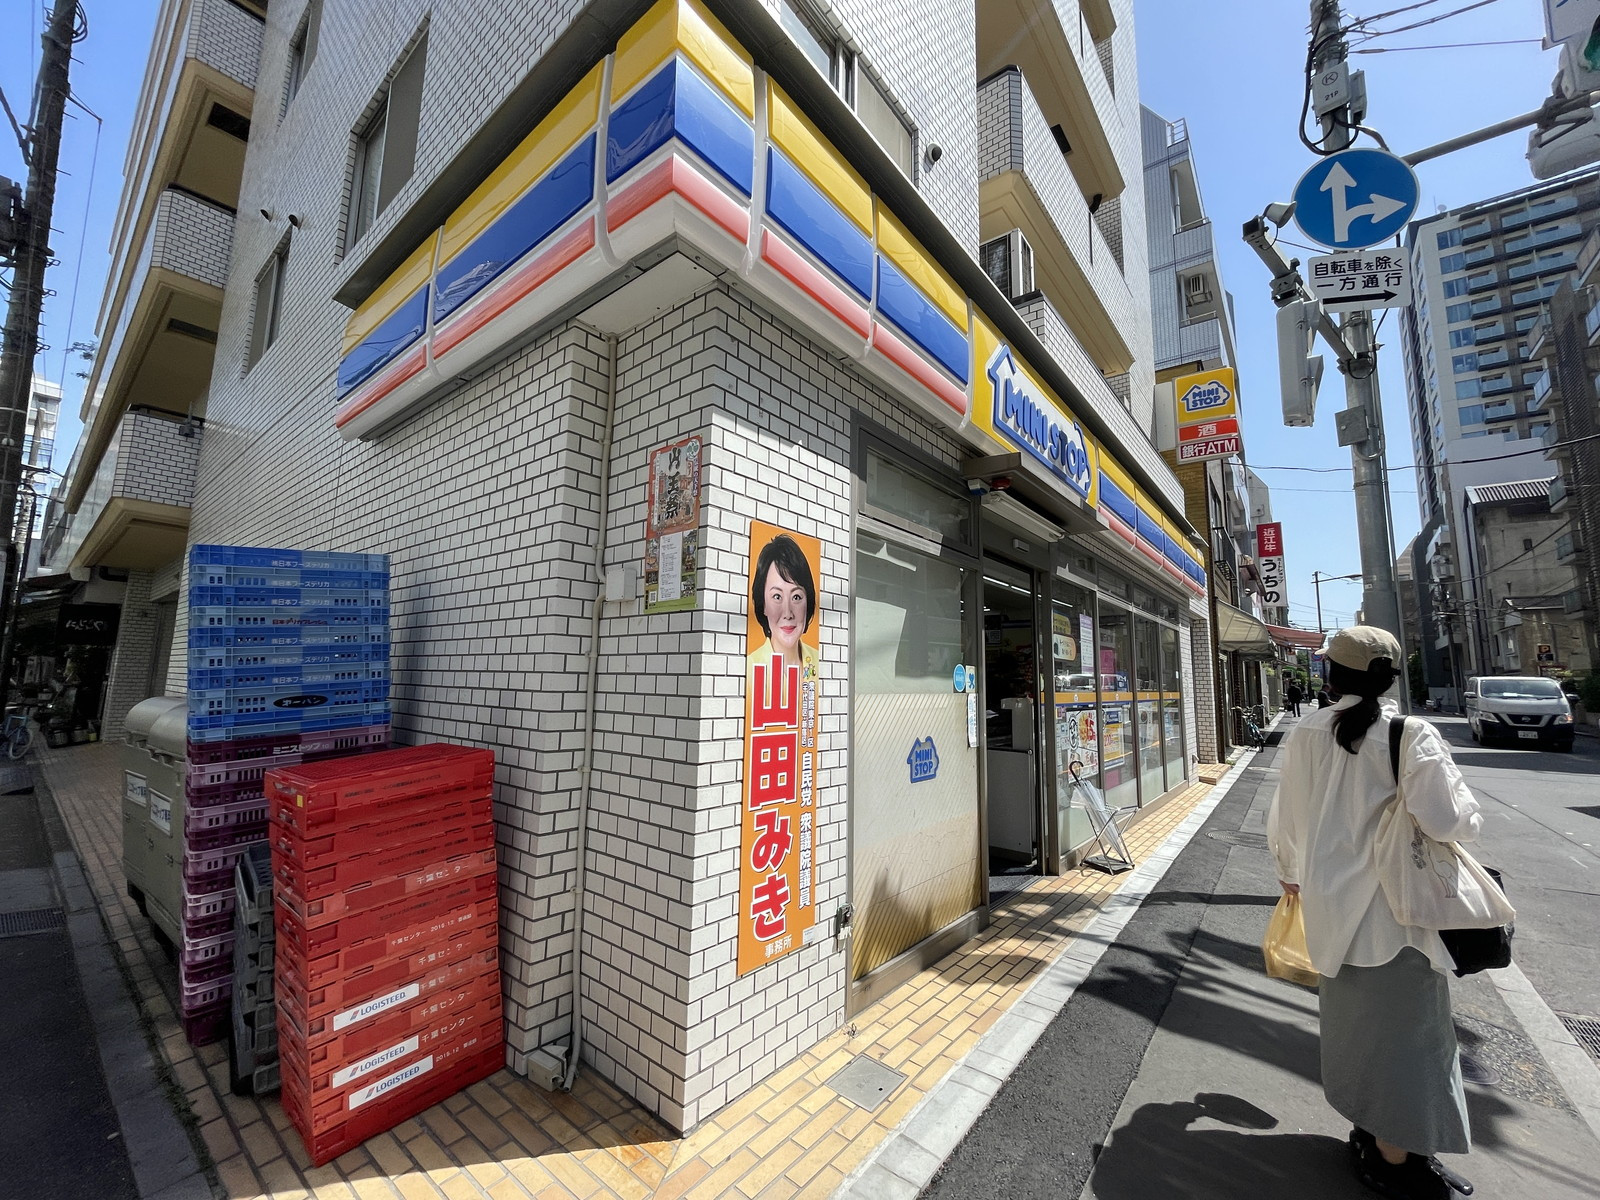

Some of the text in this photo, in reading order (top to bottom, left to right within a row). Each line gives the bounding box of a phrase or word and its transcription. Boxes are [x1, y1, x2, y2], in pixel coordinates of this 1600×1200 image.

[1314, 255, 1404, 277] 自転車を除く
[1316, 272, 1403, 291] 一方通行
[1191, 395, 1221, 408] STOP
[1192, 387, 1219, 400] MINI
[1004, 377, 1087, 481] MINI STOP
[1198, 423, 1217, 437] 酒
[1182, 438, 1237, 459] 銀行ATM
[1263, 527, 1277, 553] 近江牛
[1261, 558, 1281, 604] うちの
[272, 742, 321, 755] ミニストップ
[915, 748, 933, 763] MINI
[800, 751, 813, 808] 自民党
[914, 760, 934, 777] STOP
[748, 652, 800, 942] 山田みき
[764, 933, 794, 958] 事務所
[360, 991, 406, 1016] LOGISTEED
[360, 1045, 405, 1072] LOGISTEED
[376, 1065, 420, 1093] LOGISTEED
